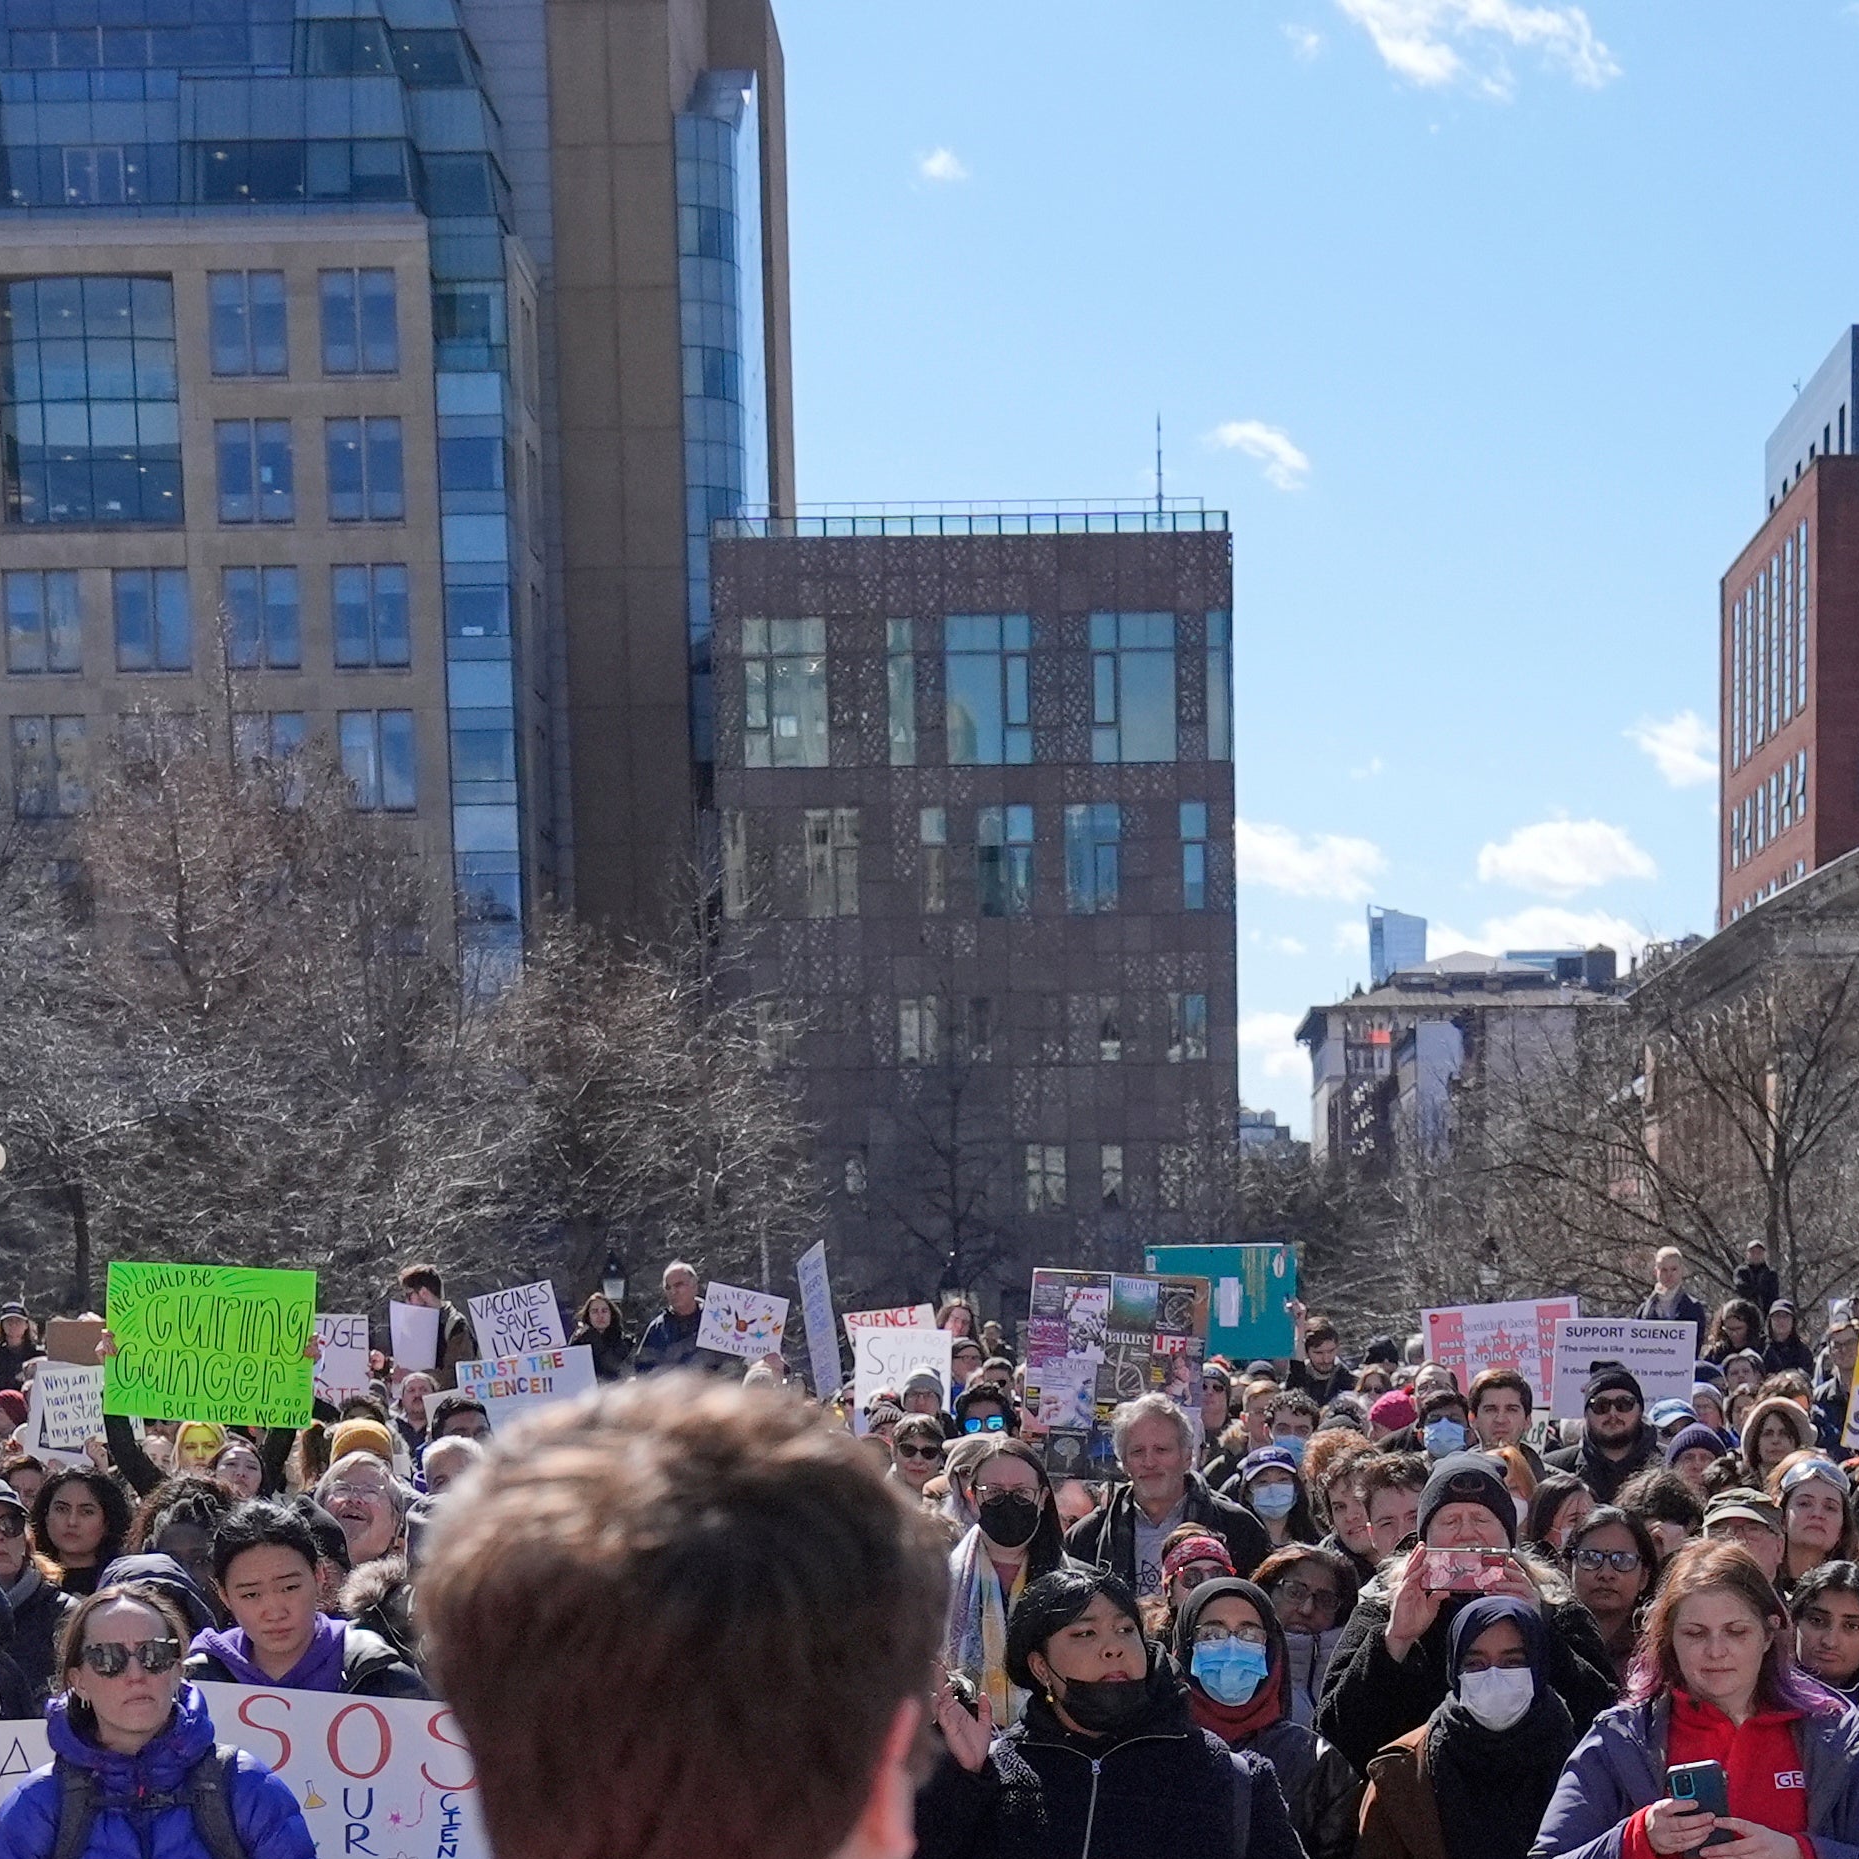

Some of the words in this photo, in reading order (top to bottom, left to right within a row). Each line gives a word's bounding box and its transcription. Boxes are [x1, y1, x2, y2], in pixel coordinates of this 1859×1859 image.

[1116, 1278, 1155, 1292] nature
[469, 1283, 551, 1320] VACCINES
[708, 1290, 758, 1304] BELIEVE
[495, 1308, 542, 1335] SAVE
[847, 1306, 920, 1329] SCIENCE
[315, 1318, 366, 1350] DGE
[701, 1328, 771, 1353] EVOLUTION
[1105, 1331, 1151, 1345] nature
[1565, 1327, 1625, 1338] SUPPORT
[1630, 1327, 1687, 1340] SCIENCE
[492, 1327, 552, 1358] LIVES
[1439, 1338, 1467, 1349] make
[1579, 1345, 1600, 1353] mind
[1610, 1345, 1625, 1353] like
[1635, 1347, 1676, 1356] parachute
[461, 1358, 519, 1381] TRUST
[527, 1352, 565, 1373] THE
[1047, 1358, 1091, 1371] Science
[1439, 1351, 1512, 1366] DEFUNDING
[42, 1375, 70, 1394] Why
[162, 1400, 197, 1420] BUT
[52, 1428, 70, 1444] my
